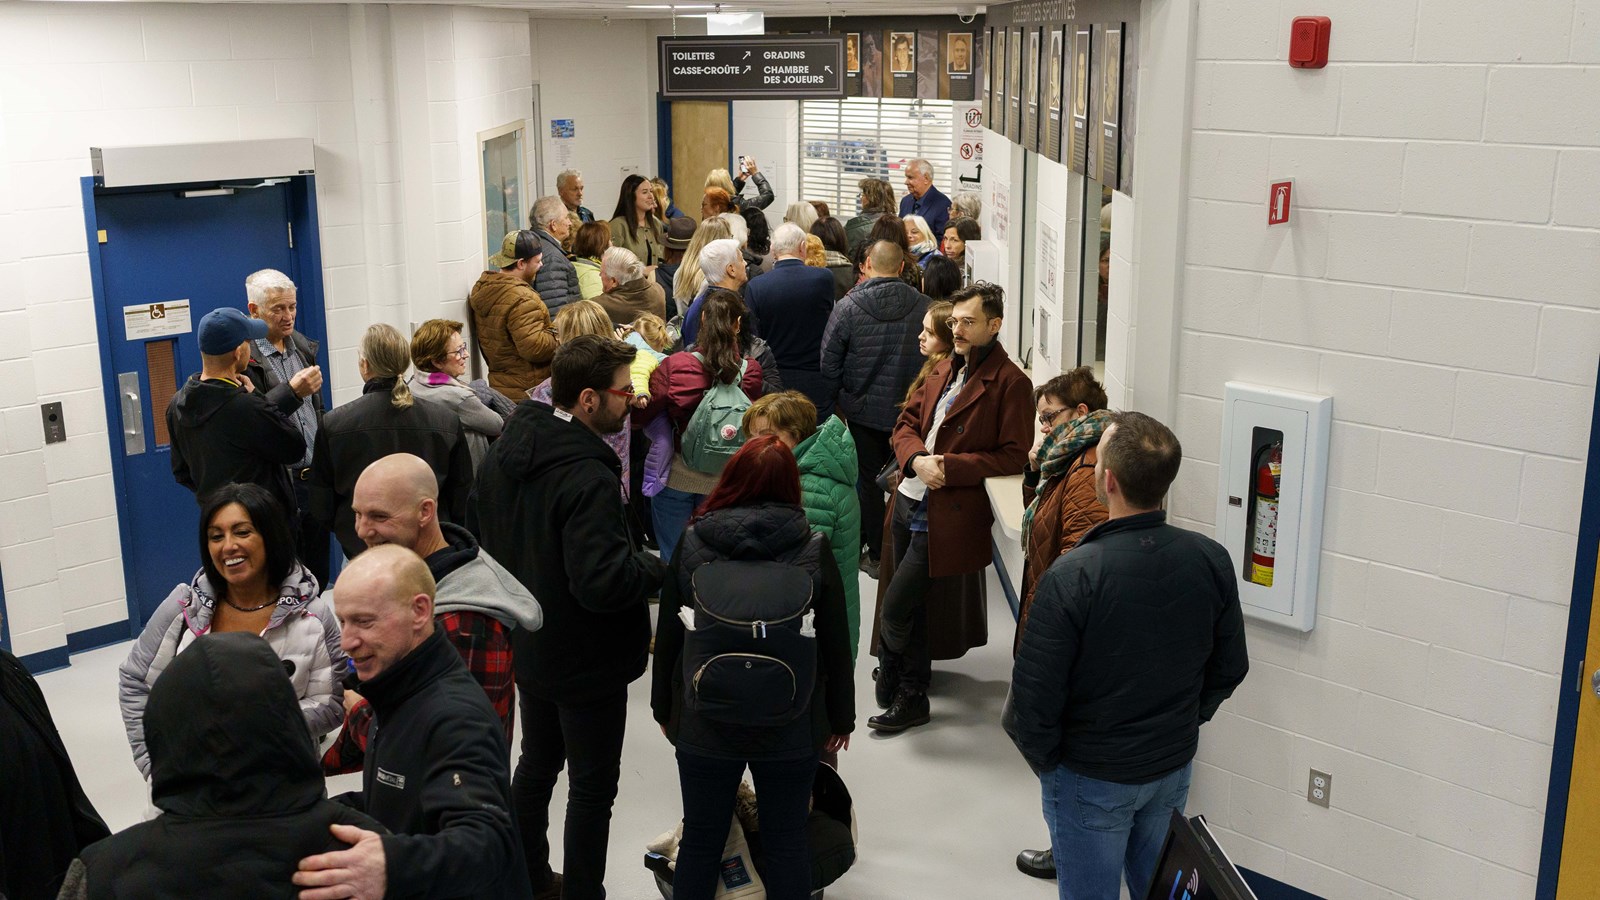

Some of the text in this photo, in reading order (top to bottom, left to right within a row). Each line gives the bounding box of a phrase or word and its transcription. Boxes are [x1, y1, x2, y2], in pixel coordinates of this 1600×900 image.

[1042, 0, 1076, 20] SPORTIVES
[672, 52, 715, 60] TOILETTES
[763, 51, 805, 59] GRADINS
[673, 65, 740, 75] CASSE-CROÛTE
[763, 65, 809, 74] CHAMBRE
[763, 75, 824, 84] DES JOUEURS
